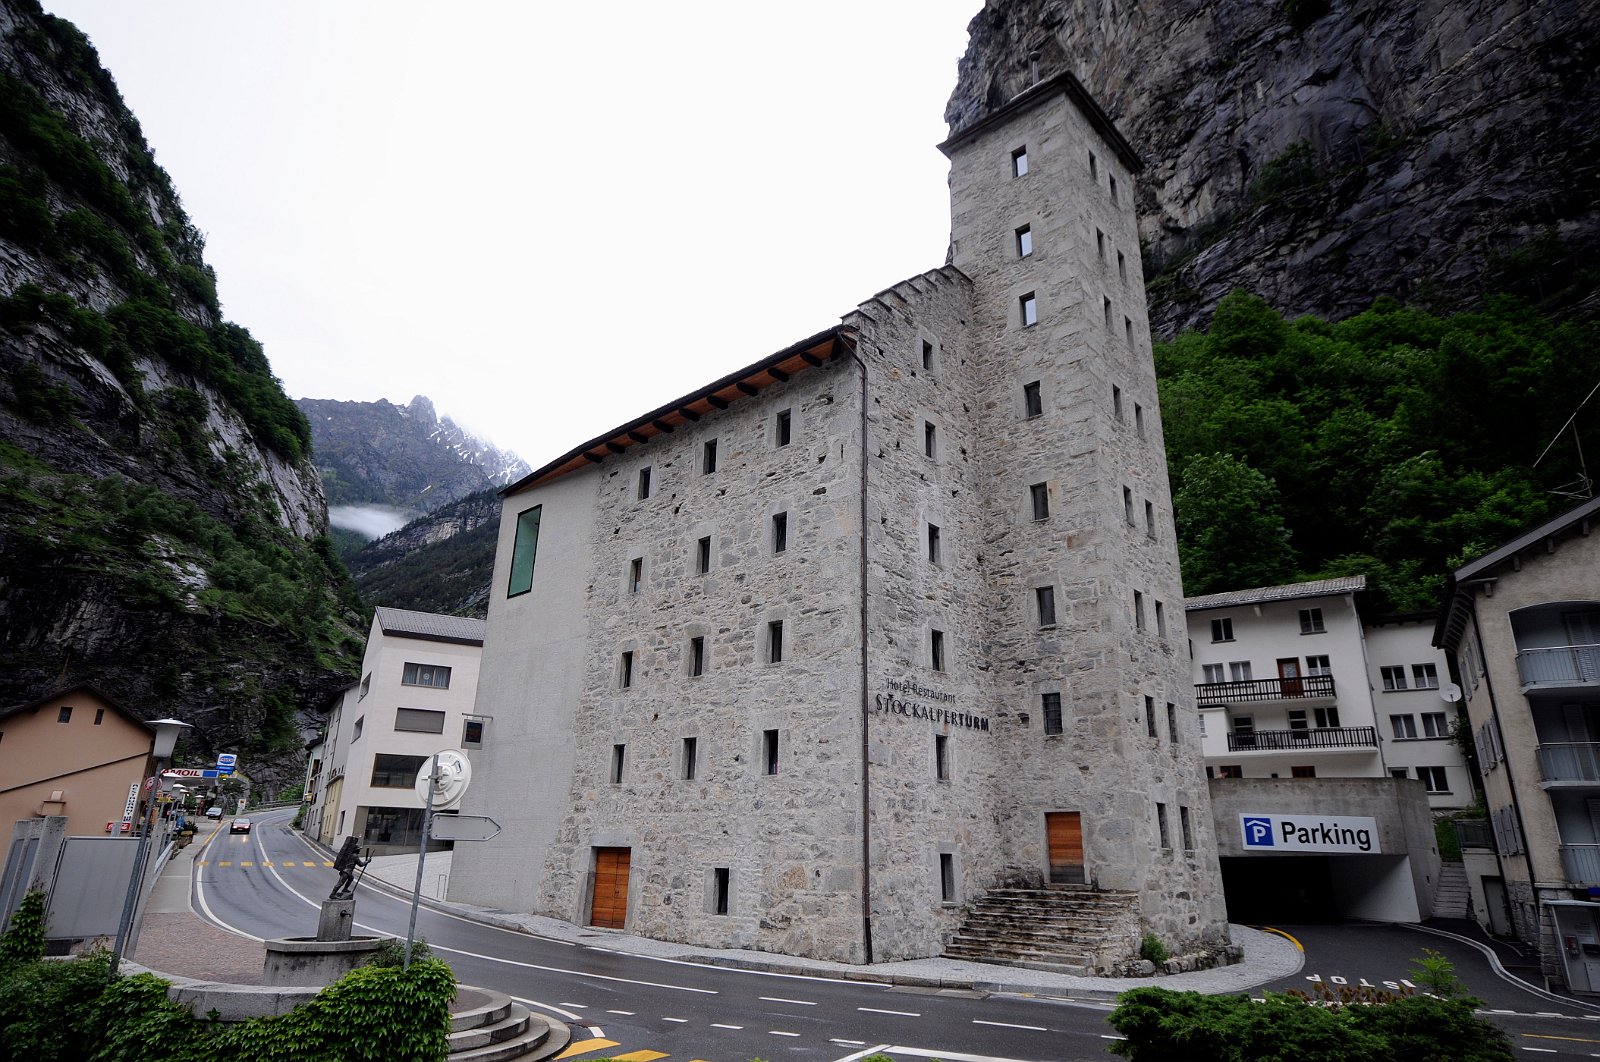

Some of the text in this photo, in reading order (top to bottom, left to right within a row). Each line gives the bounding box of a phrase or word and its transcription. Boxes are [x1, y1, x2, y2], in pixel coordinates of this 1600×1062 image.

[876, 693, 988, 731] STOCKALPERTURM
[161, 768, 200, 776] AMOIL
[1252, 822, 1371, 851] P Parking
[1306, 973, 1399, 989] STOP
